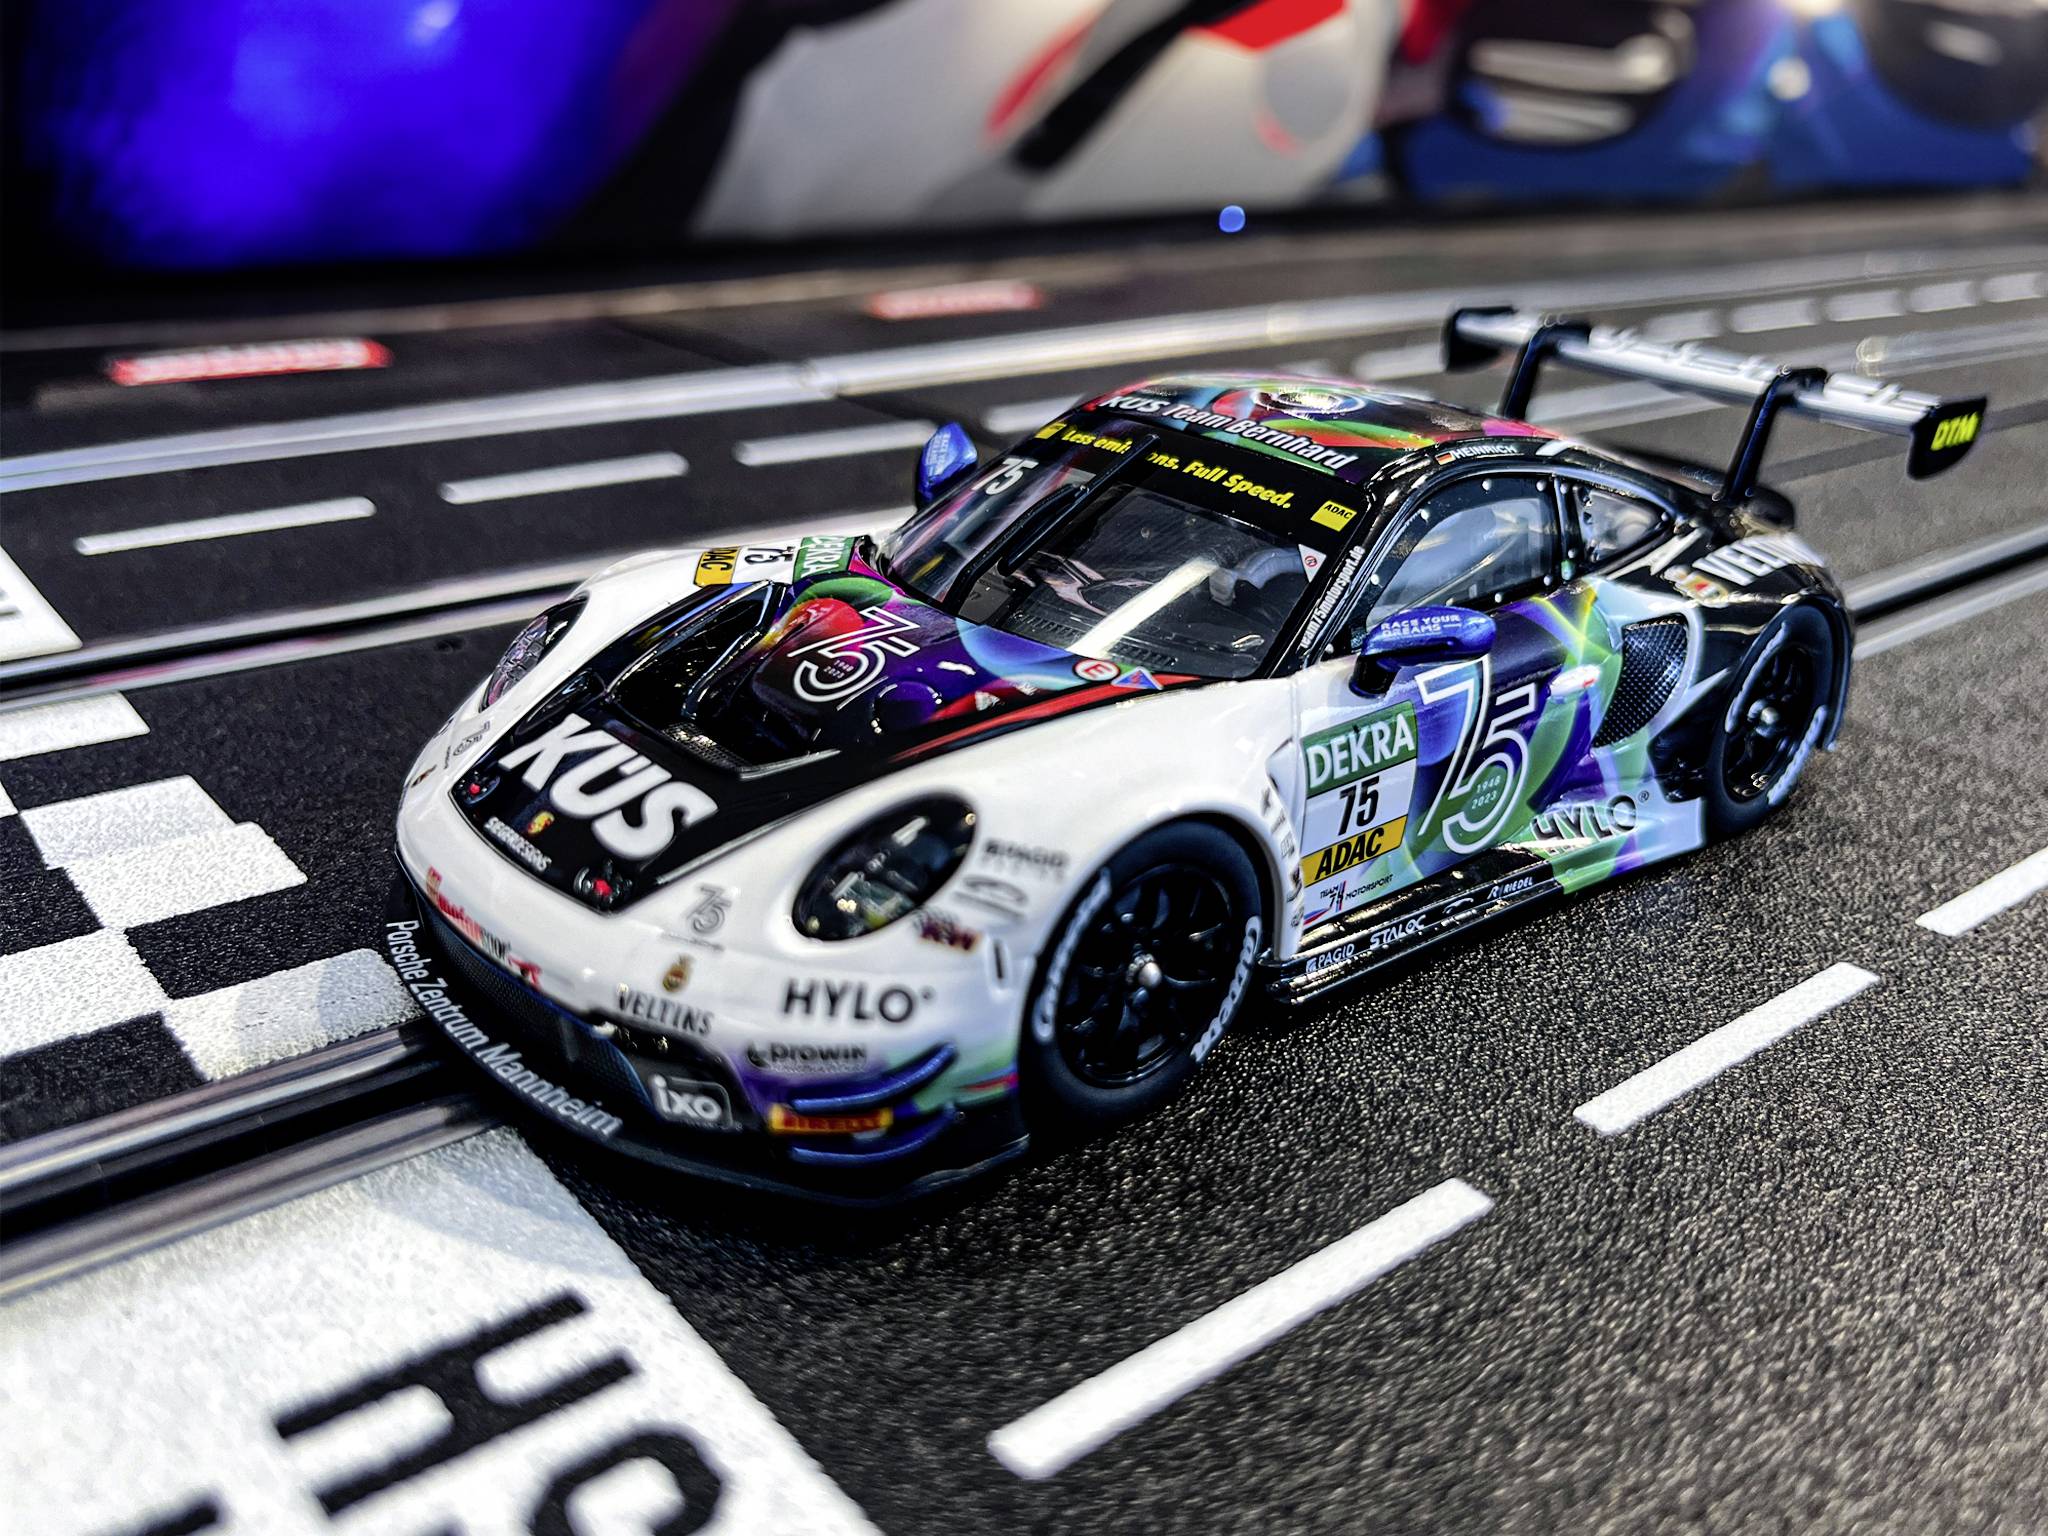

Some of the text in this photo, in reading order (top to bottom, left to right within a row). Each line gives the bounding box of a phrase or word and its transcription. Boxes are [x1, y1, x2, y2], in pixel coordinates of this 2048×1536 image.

[1162, 403, 1230, 431] Team
[1226, 419, 1359, 471] Bernhard
[1452, 444, 1518, 459] HEINRICH
[1930, 411, 1979, 452] DTM
[971, 457, 1039, 495] 75
[1061, 430, 1096, 446] Less
[1182, 461, 1228, 482] Full
[1222, 475, 1294, 508] Speed.
[1324, 503, 1353, 520] ADAC
[1300, 545, 1366, 649] team75motorsport.de
[1381, 614, 1461, 631] RACE YOUR
[1382, 624, 1441, 637] DREAMS
[786, 605, 921, 702] 75
[1305, 713, 1415, 788] DEKRA
[1414, 655, 1537, 855] 75
[1338, 775, 1380, 836] 75
[1472, 790, 1498, 810] 2023
[1314, 827, 1384, 880] ADAC
[1345, 874, 1394, 901] MOTORSPORT
[1503, 877, 1533, 893] RIEDEL
[1318, 943, 1355, 966] PAGID
[386, 920, 432, 981] Porsche
[409, 977, 490, 1056] Zentrum
[476, 1043, 624, 1138] Mannheim
[616, 990, 715, 1036] VELTINS
